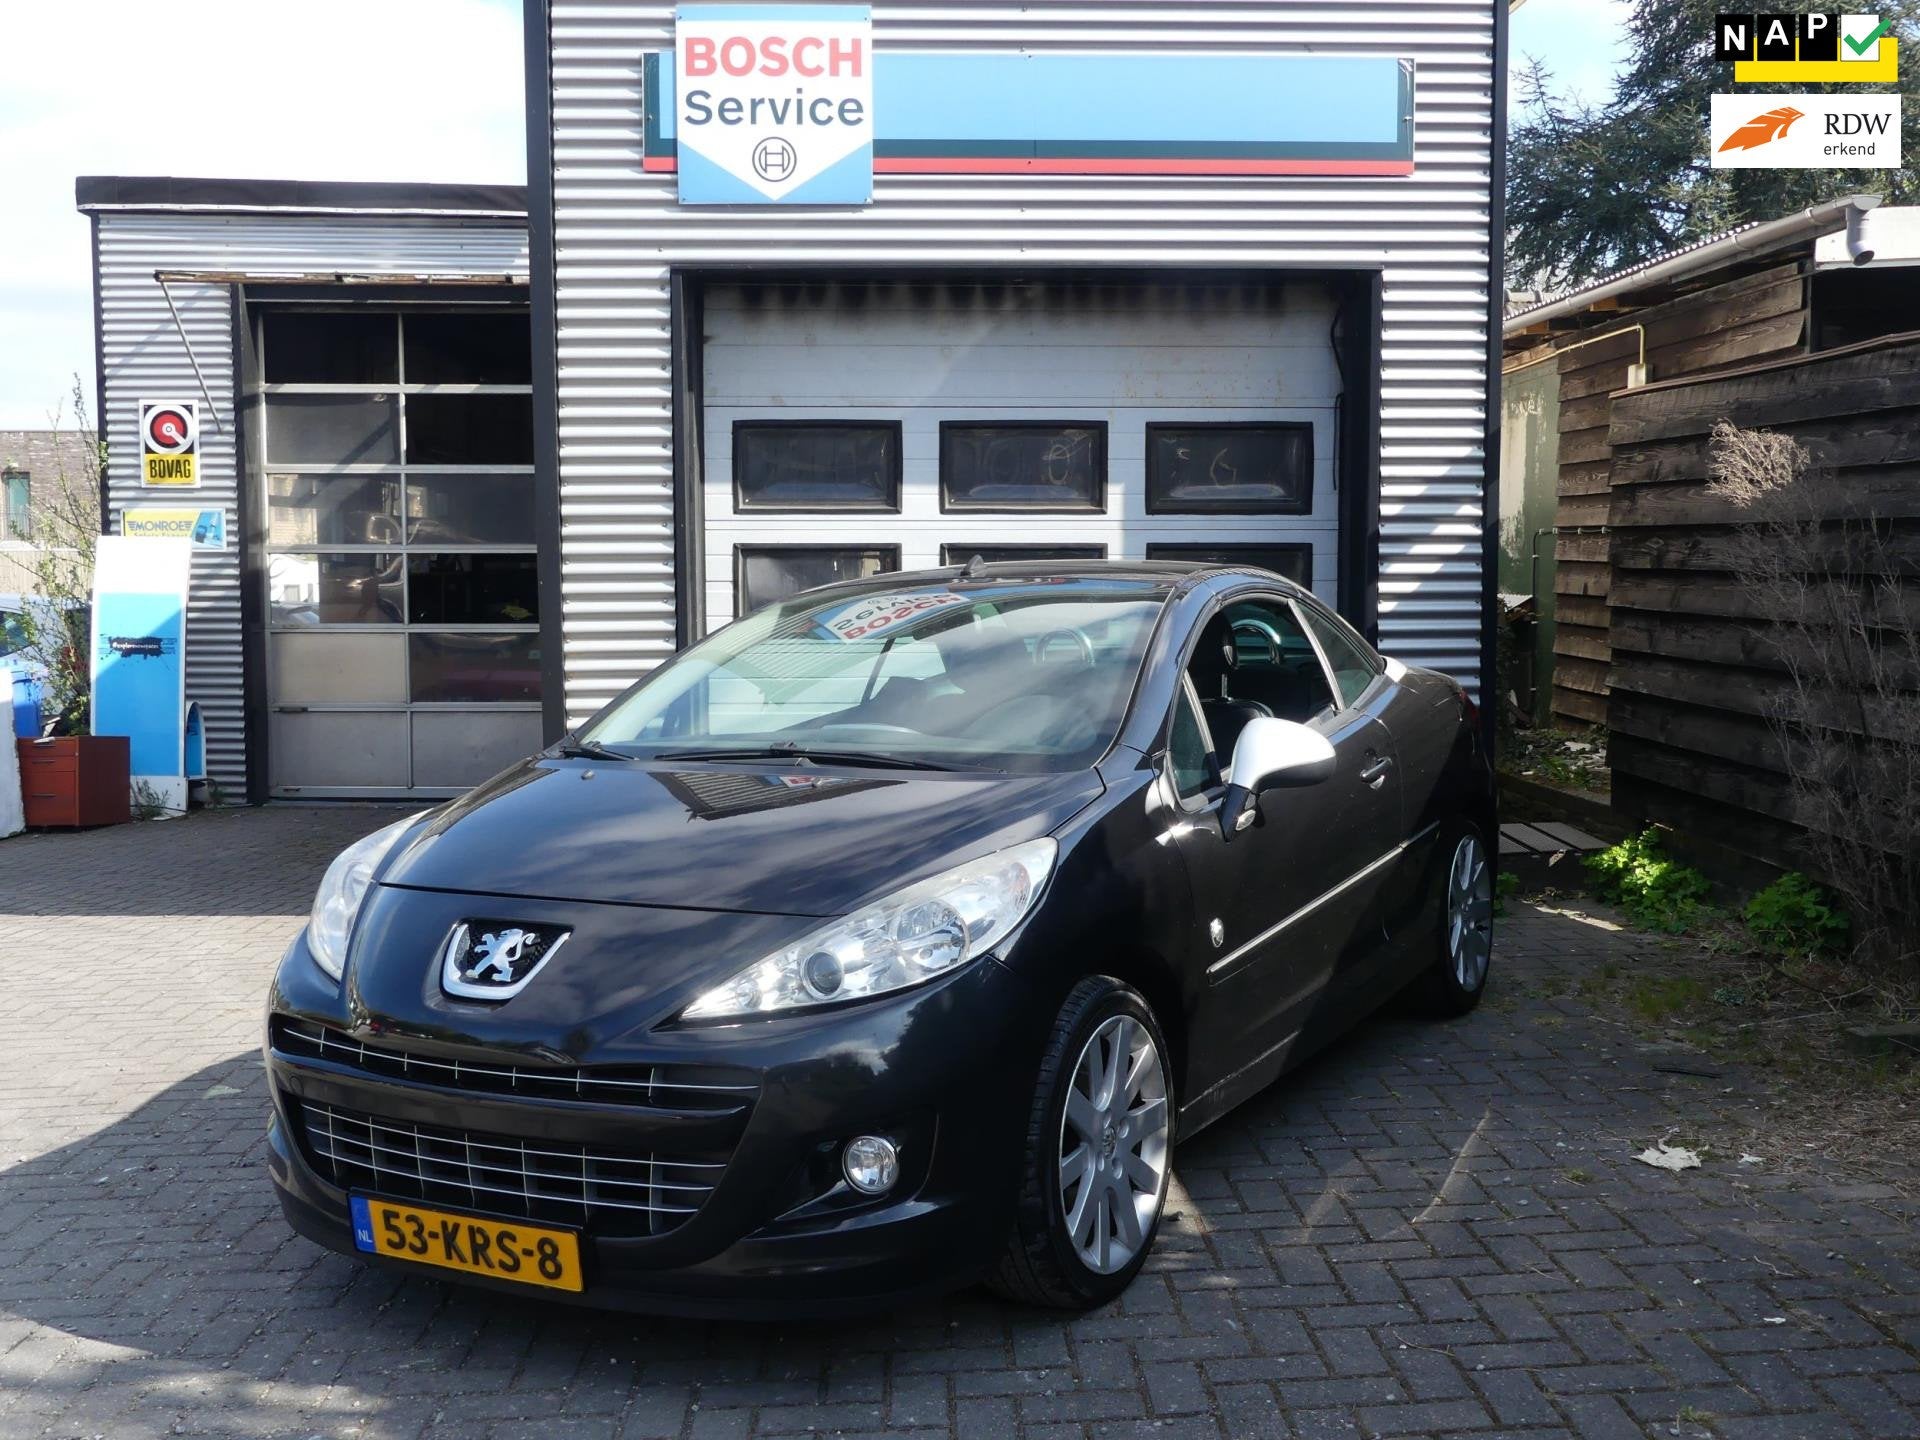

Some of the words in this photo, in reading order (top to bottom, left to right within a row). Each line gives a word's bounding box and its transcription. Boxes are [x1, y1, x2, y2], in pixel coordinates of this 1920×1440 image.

[685, 36, 862, 77] BOSCH
[684, 88, 864, 126] Service
[149, 459, 191, 478] BOVAG
[135, 521, 184, 531] MONROE
[358, 1229, 373, 1243] NL
[382, 1209, 563, 1280] 53-KRS-8
